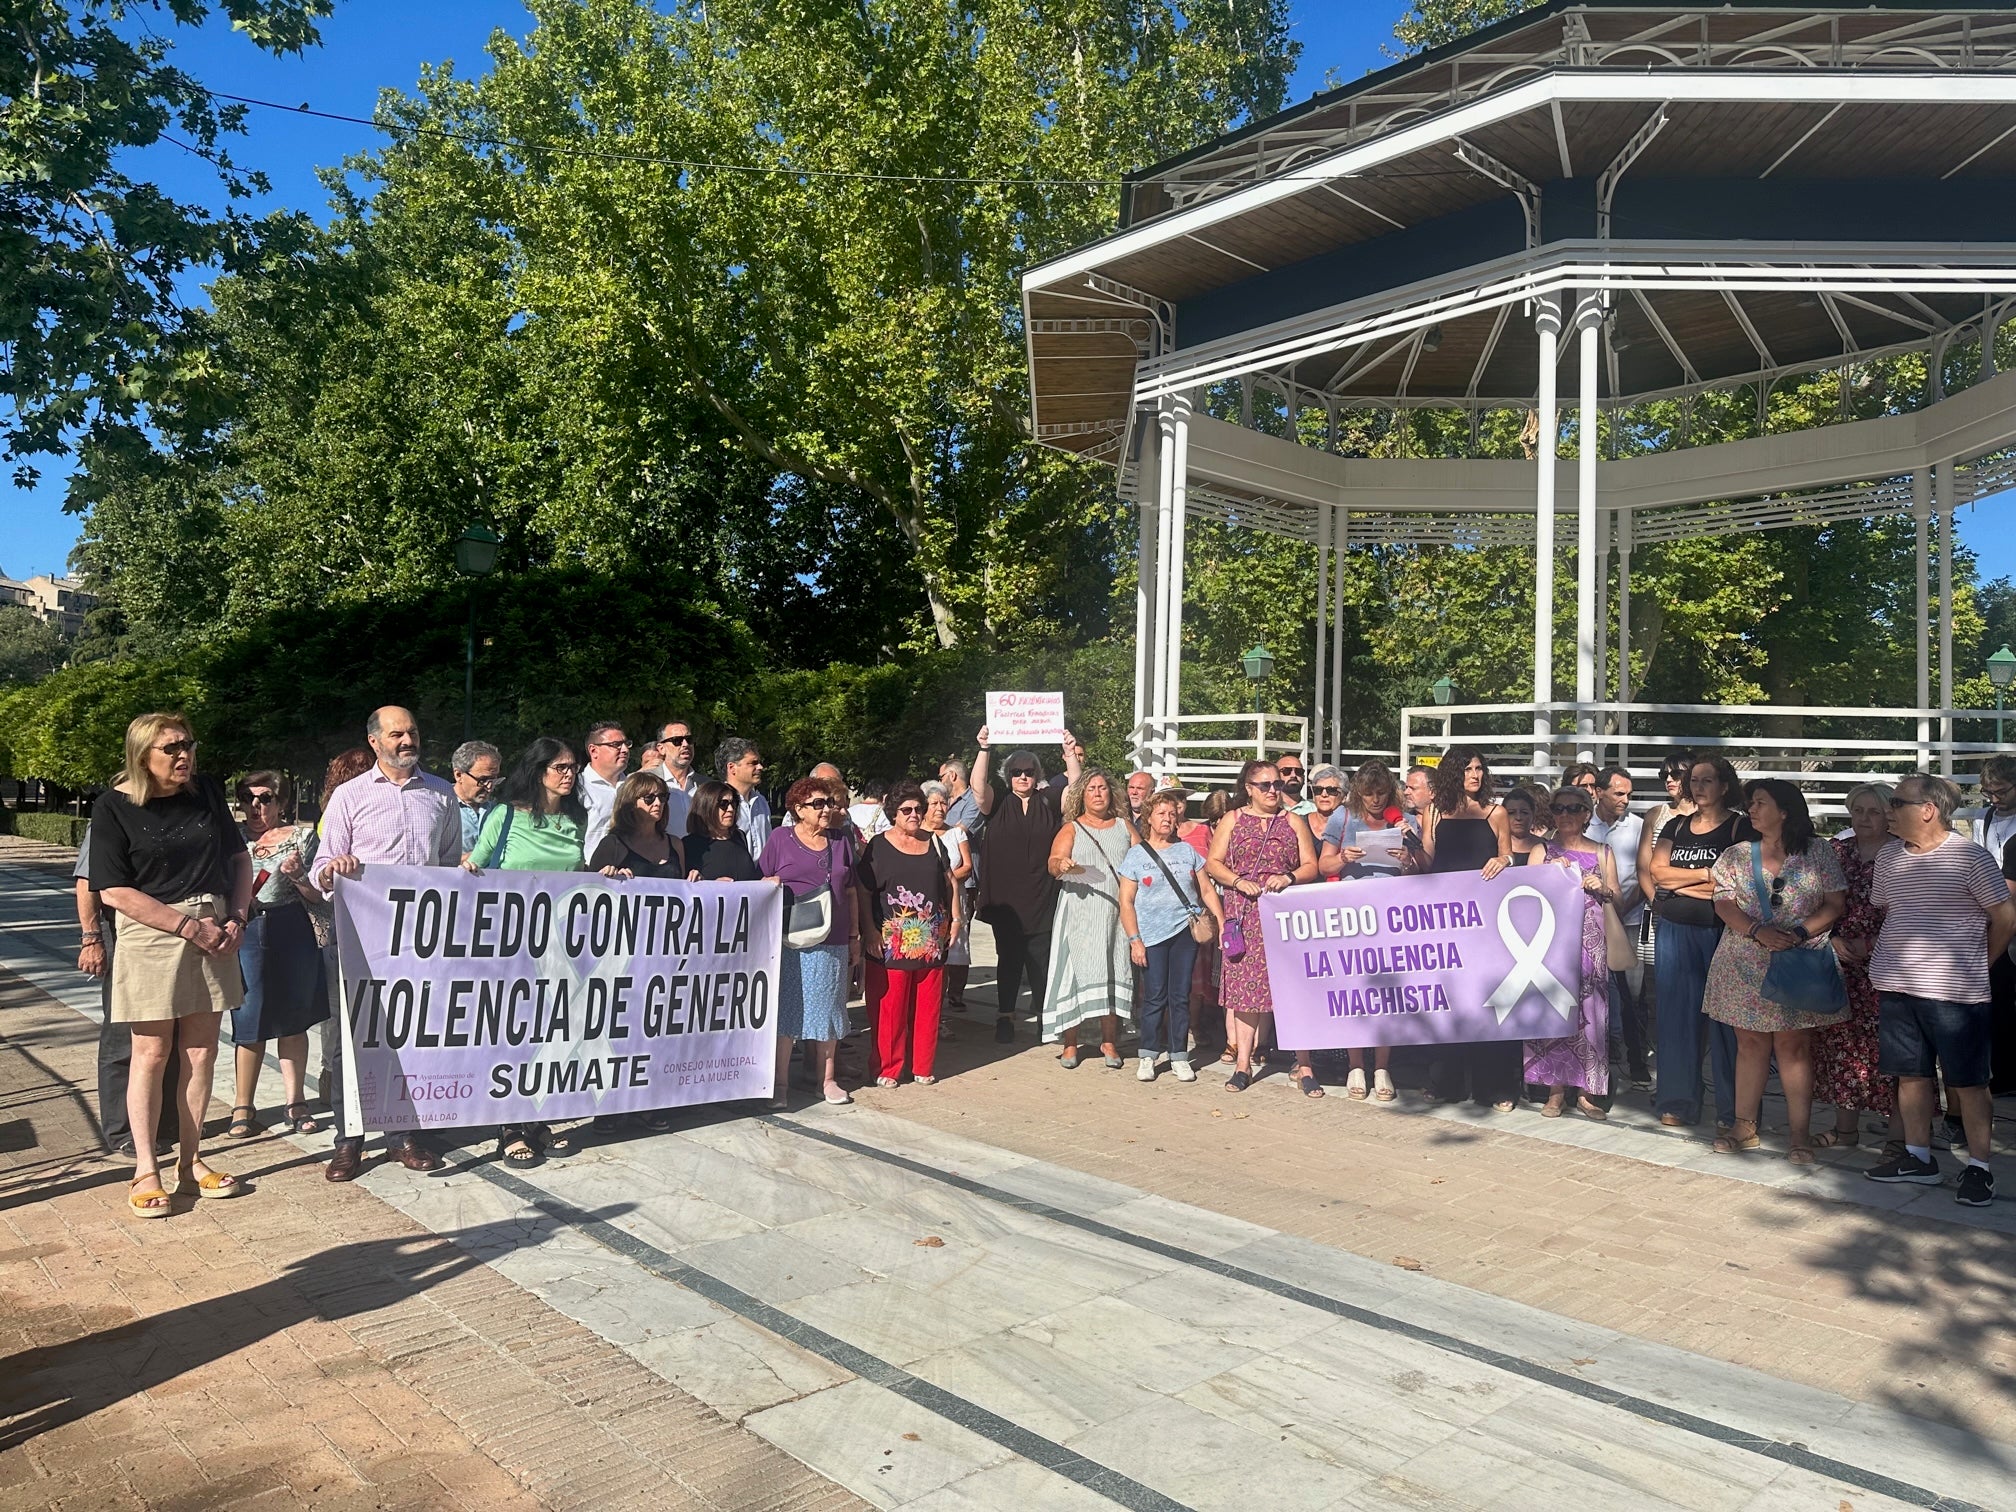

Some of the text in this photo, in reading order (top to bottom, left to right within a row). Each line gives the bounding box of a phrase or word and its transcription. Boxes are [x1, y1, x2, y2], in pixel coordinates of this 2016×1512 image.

[999, 693, 1016, 706] 60
[388, 888, 749, 959] TOLEDO CONTRA LA
[1274, 900, 1483, 941] TOLEDO CONTRA
[1303, 942, 1463, 979] LA VIOLENCIA
[343, 958, 769, 1050] VIOLENCIA DE GÉNERO
[1326, 983, 1450, 1018] MACHISTA
[419, 1073, 466, 1081] Ayuntamiento
[488, 1054, 651, 1099] SUMATE
[663, 1056, 757, 1073] CONSEJO MUNICIPAL
[678, 1070, 740, 1085] DE LA MUJER
[394, 1074, 473, 1101] Toledo
[362, 1112, 458, 1125] EJALIA DE IGUALDAD
